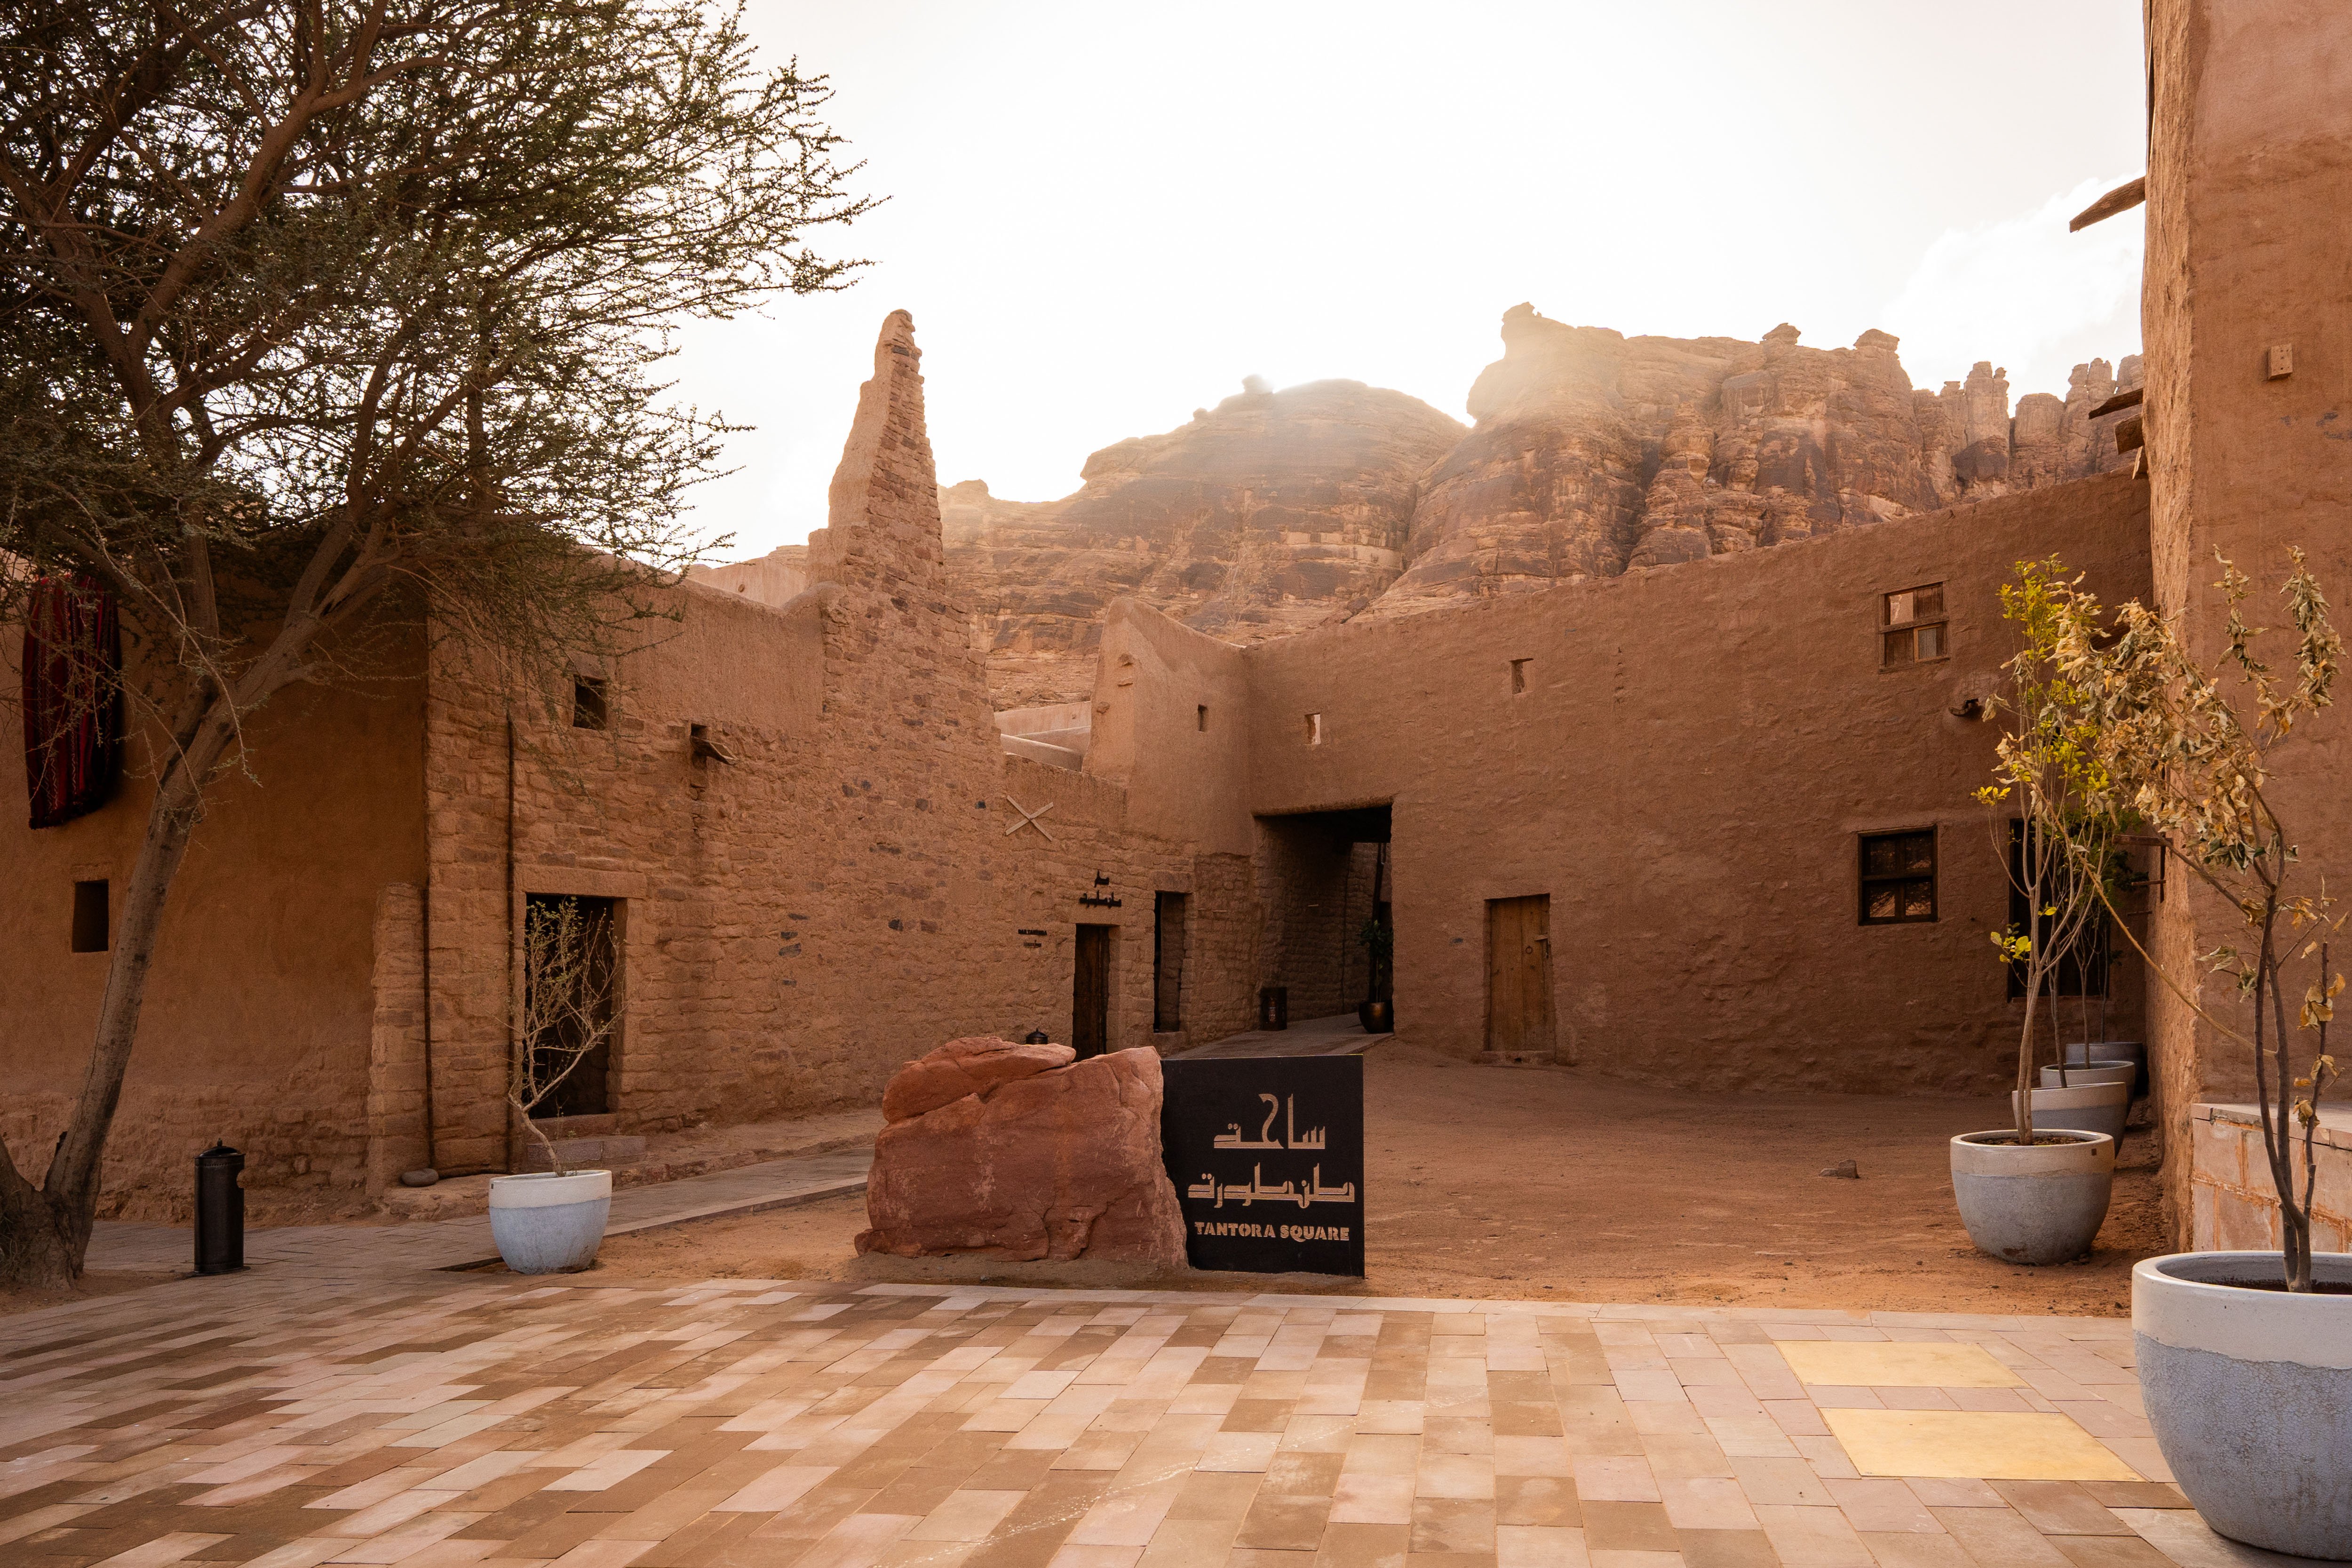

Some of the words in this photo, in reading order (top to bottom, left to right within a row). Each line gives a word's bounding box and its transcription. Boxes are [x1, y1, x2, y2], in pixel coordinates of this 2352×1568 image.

[1213, 1093, 1326, 1149] ساحة
[1188, 1162, 1355, 1209] طنطورة
[1194, 1222, 1276, 1238] TANTORA
[1280, 1225, 1350, 1242] SQUARE
